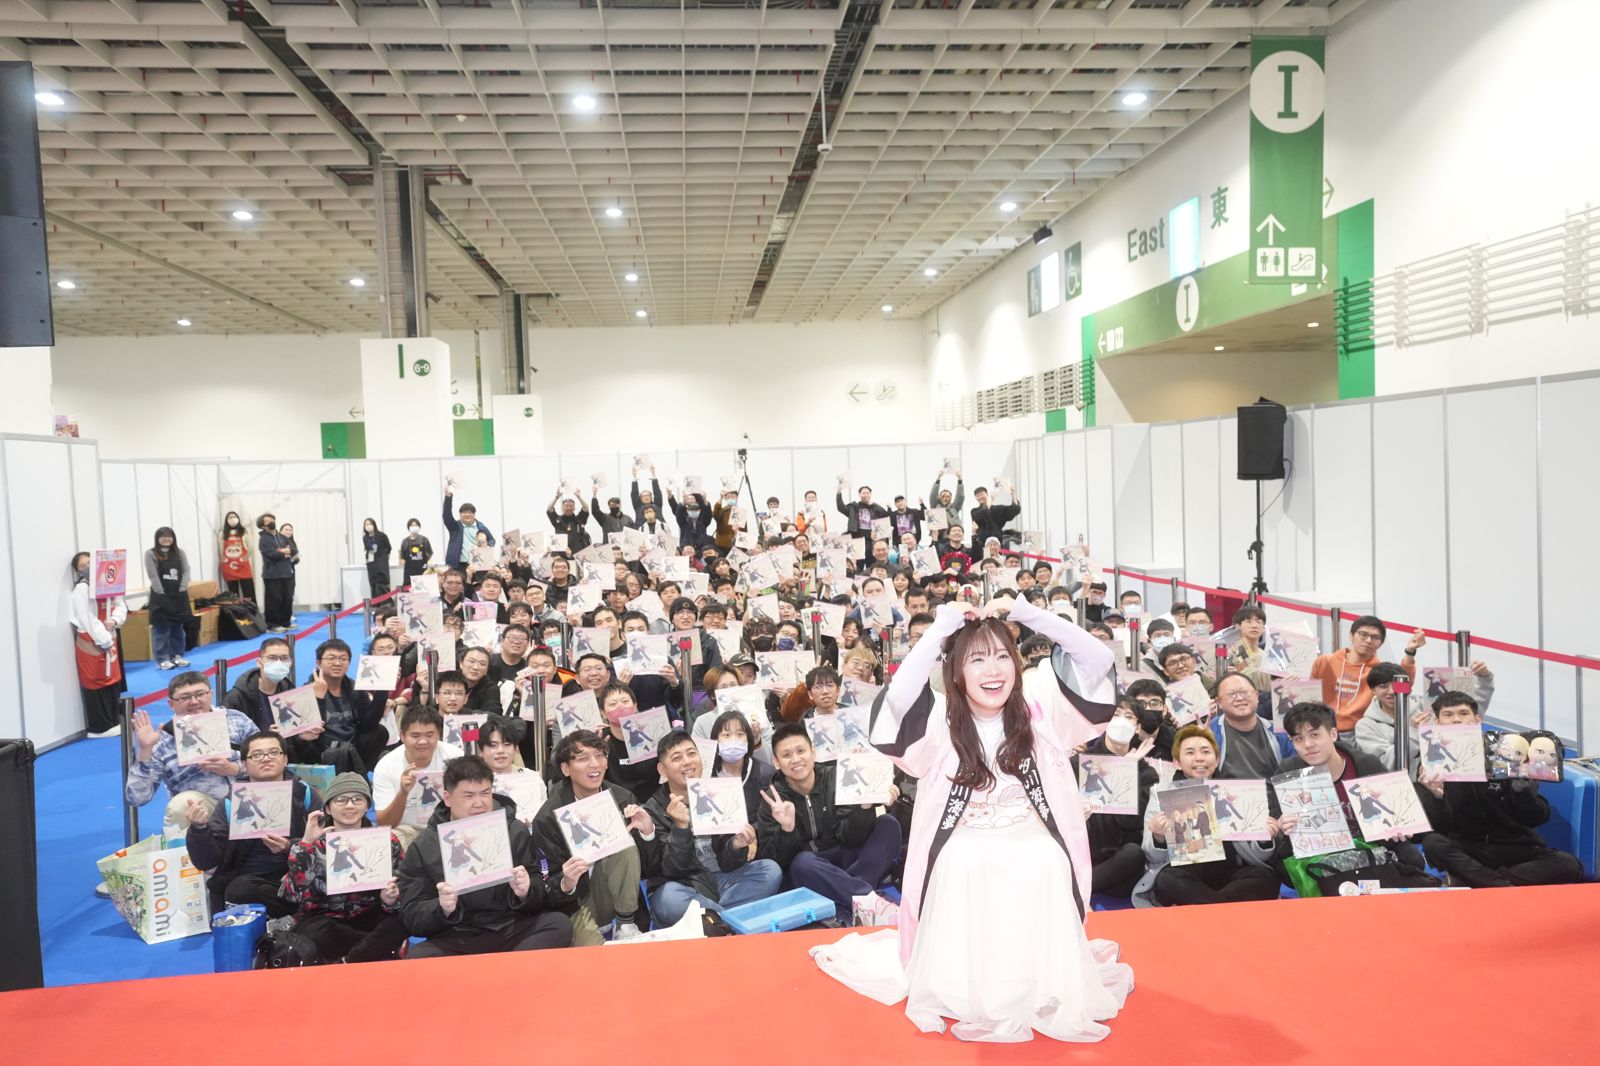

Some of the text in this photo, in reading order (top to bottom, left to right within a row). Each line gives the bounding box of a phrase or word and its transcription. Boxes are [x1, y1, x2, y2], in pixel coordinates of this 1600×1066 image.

[1277, 65, 1299, 119] I
[1210, 186, 1229, 230] 東
[1127, 217, 1165, 263] East
[1183, 283, 1191, 324] I
[414, 363, 430, 374] 6-9
[152, 858, 172, 937] amiami
